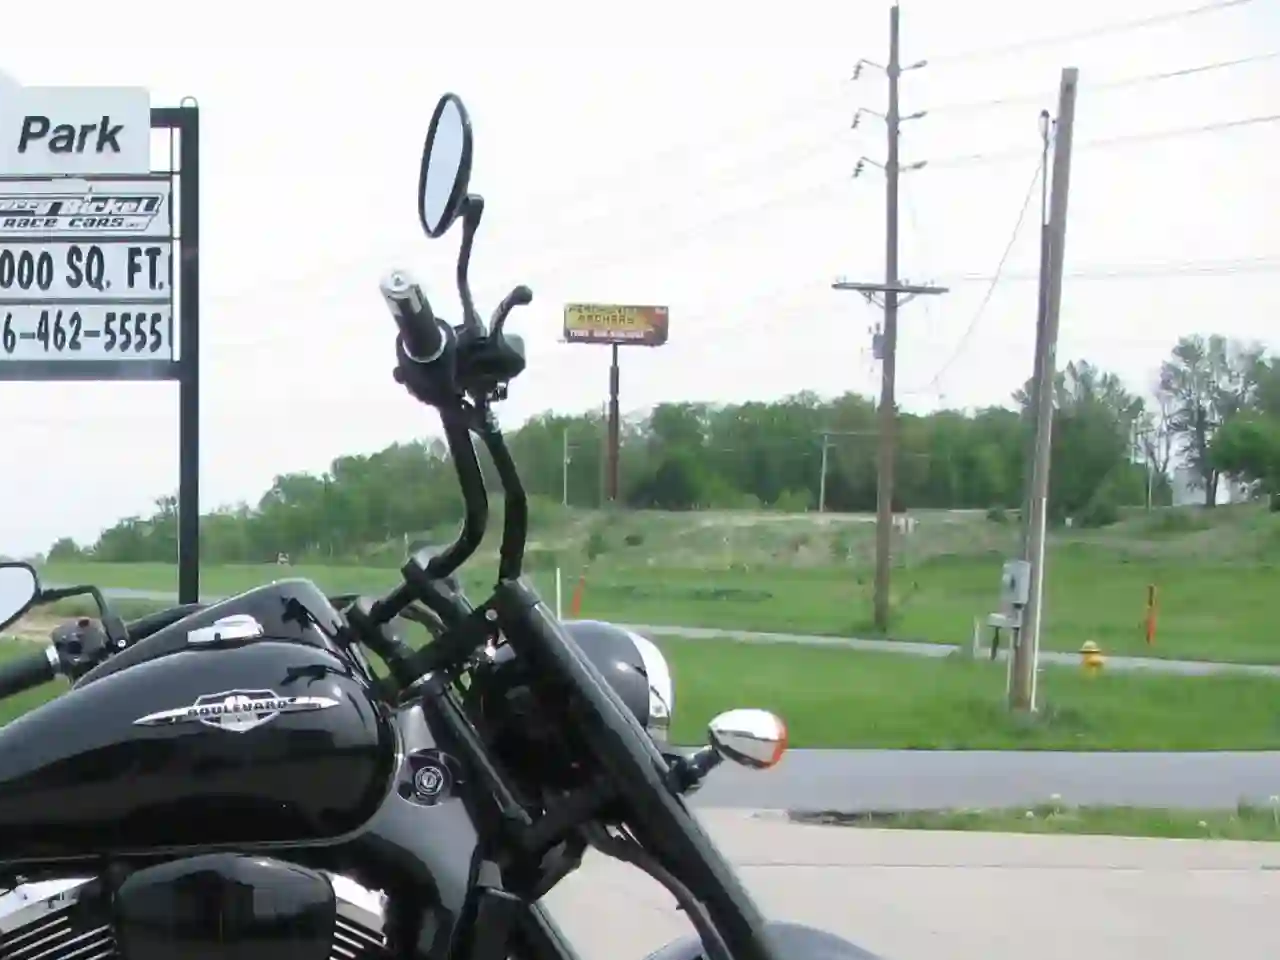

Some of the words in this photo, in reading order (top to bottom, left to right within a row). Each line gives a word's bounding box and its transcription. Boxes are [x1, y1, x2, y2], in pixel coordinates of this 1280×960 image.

[17, 115, 124, 153] Park
[65, 245, 111, 292] SQ.
[127, 247, 164, 290] FT.
[187, 700, 289, 717] BOULEVARD
